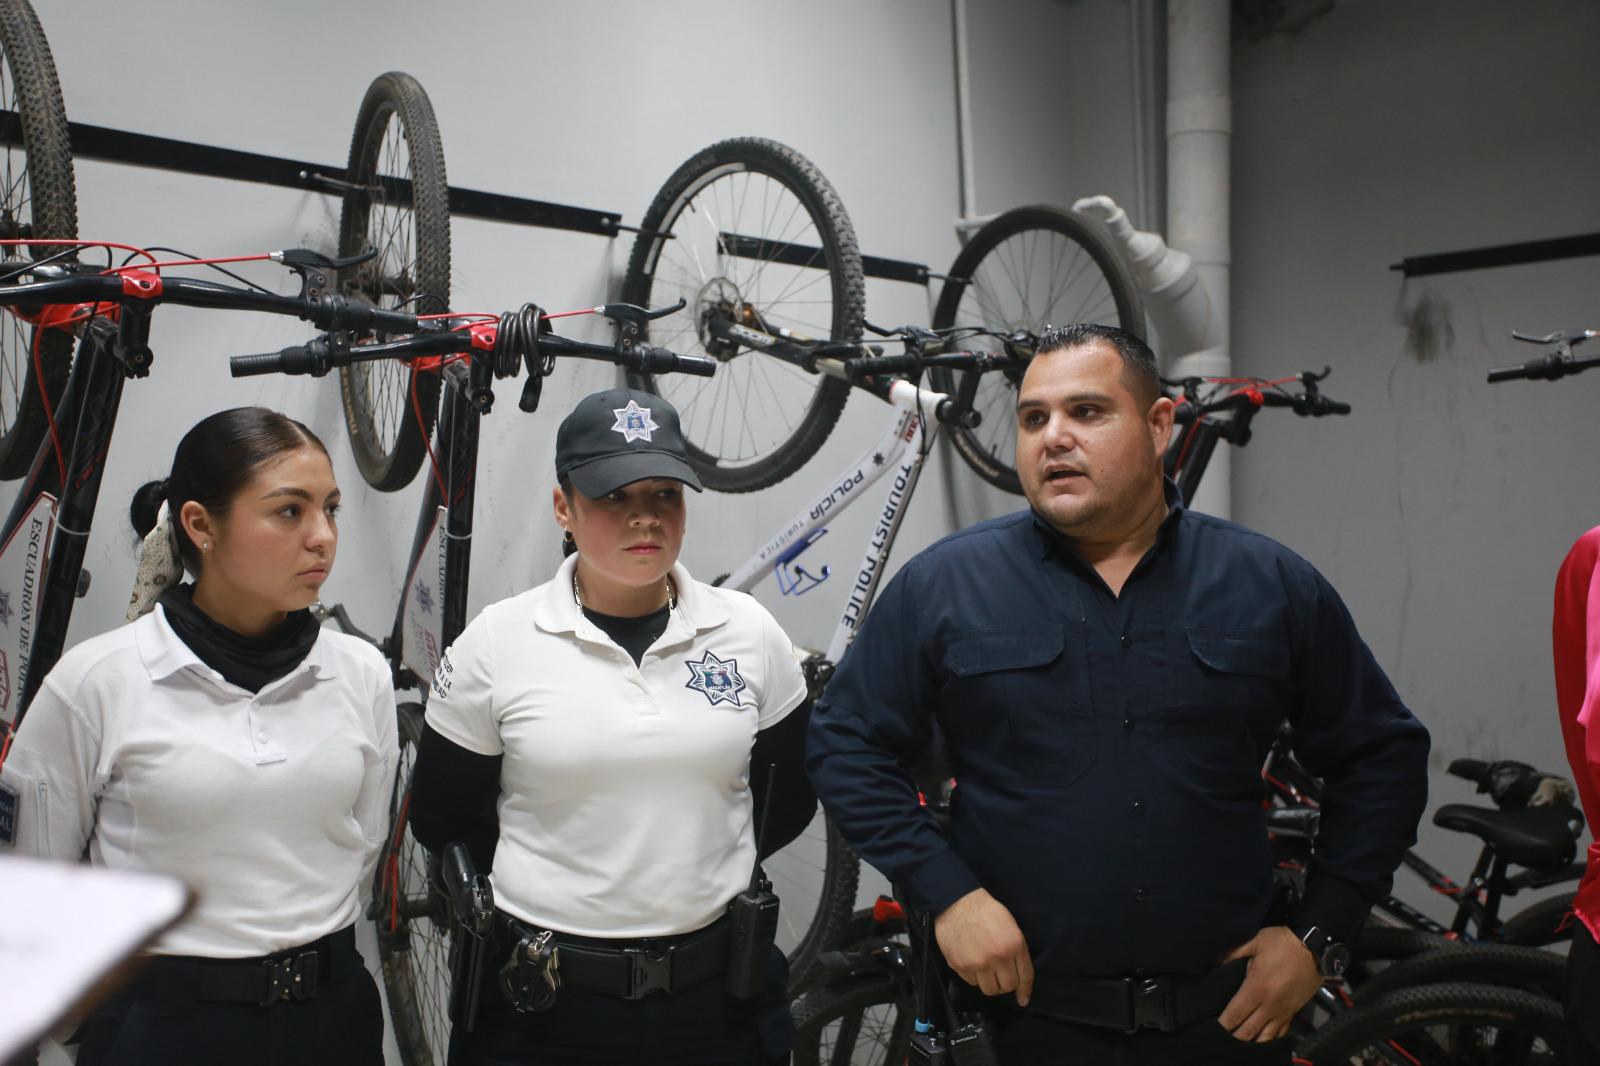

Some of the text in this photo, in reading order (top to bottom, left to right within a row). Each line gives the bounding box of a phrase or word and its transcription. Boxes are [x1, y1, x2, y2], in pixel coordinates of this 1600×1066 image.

[872, 465, 912, 553] TOURIST
[841, 555, 877, 628] POLICE
[19, 626, 30, 652] DE
